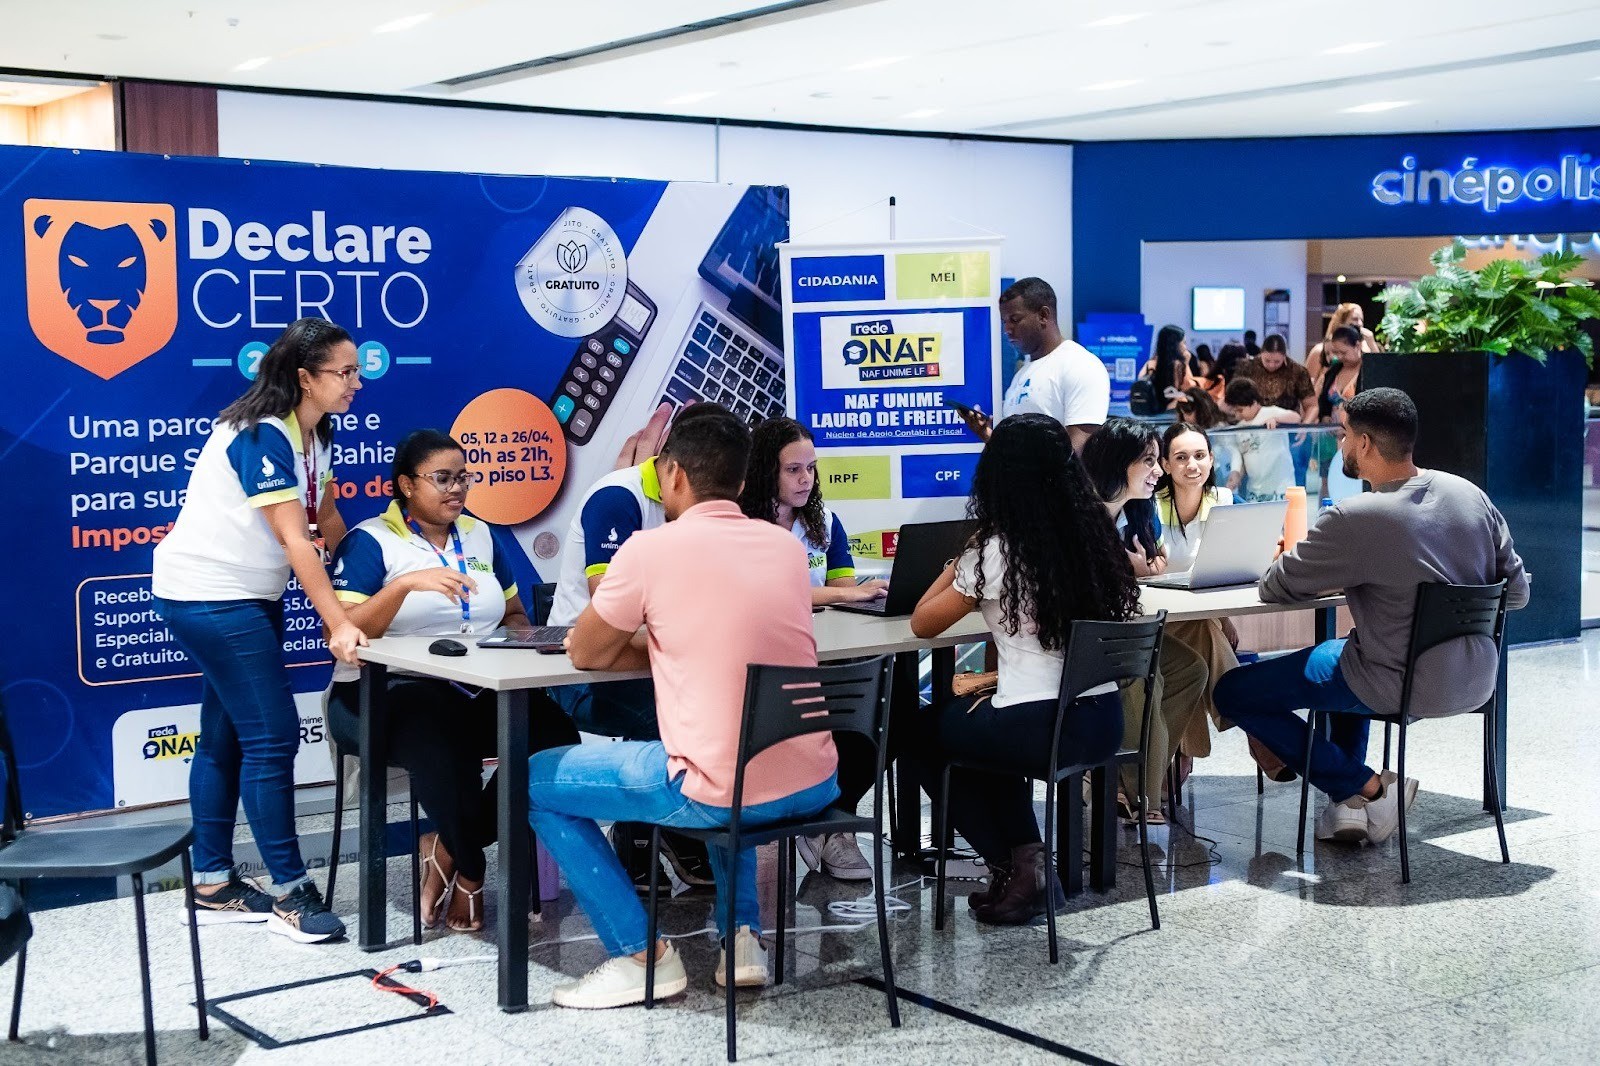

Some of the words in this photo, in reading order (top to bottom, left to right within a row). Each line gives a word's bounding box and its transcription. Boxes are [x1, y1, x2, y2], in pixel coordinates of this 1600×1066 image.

[187, 207, 432, 264] Declare
[798, 274, 879, 287] CIDADANIA
[930, 272, 956, 283] MEI
[545, 280, 600, 291] GRATUITO
[193, 268, 430, 329] CERTO
[855, 322, 889, 335] rede
[589, 341, 602, 353] GT
[608, 355, 621, 367] OFF
[862, 369, 881, 379] NAF
[882, 368, 913, 378] UNIME
[914, 367, 925, 376] LF
[844, 393, 880, 410] NAF
[883, 392, 944, 408] UNIME
[69, 415, 139, 439] Uma
[365, 412, 381, 431] e
[811, 411, 873, 429] LAURO
[876, 410, 900, 427] DE
[903, 409, 966, 427] FREITA
[461, 431, 481, 447] 05,
[484, 431, 498, 444] 12
[500, 433, 508, 443] a
[512, 429, 553, 444] 26/04,
[826, 429, 856, 439] Núcleo
[856, 429, 868, 438] de
[869, 428, 894, 438] Apoio
[895, 427, 931, 437] Contábil
[938, 426, 963, 436] Fiscal
[70, 452, 177, 479] Parque
[333, 440, 397, 466] Bahia
[496, 450, 516, 463] as
[521, 446, 553, 464] 21h,
[489, 465, 526, 486] piso
[531, 466, 555, 481] L3.
[829, 473, 859, 484] IRPF
[935, 470, 961, 482] CPF
[257, 477, 286, 490] unime
[71, 490, 135, 518] para
[144, 488, 188, 509] sua
[364, 475, 394, 497] de
[96, 627, 174, 650] Especial
[96, 657, 107, 669] e
[112, 648, 189, 668] Gratuito.
[151, 726, 175, 737] rede
